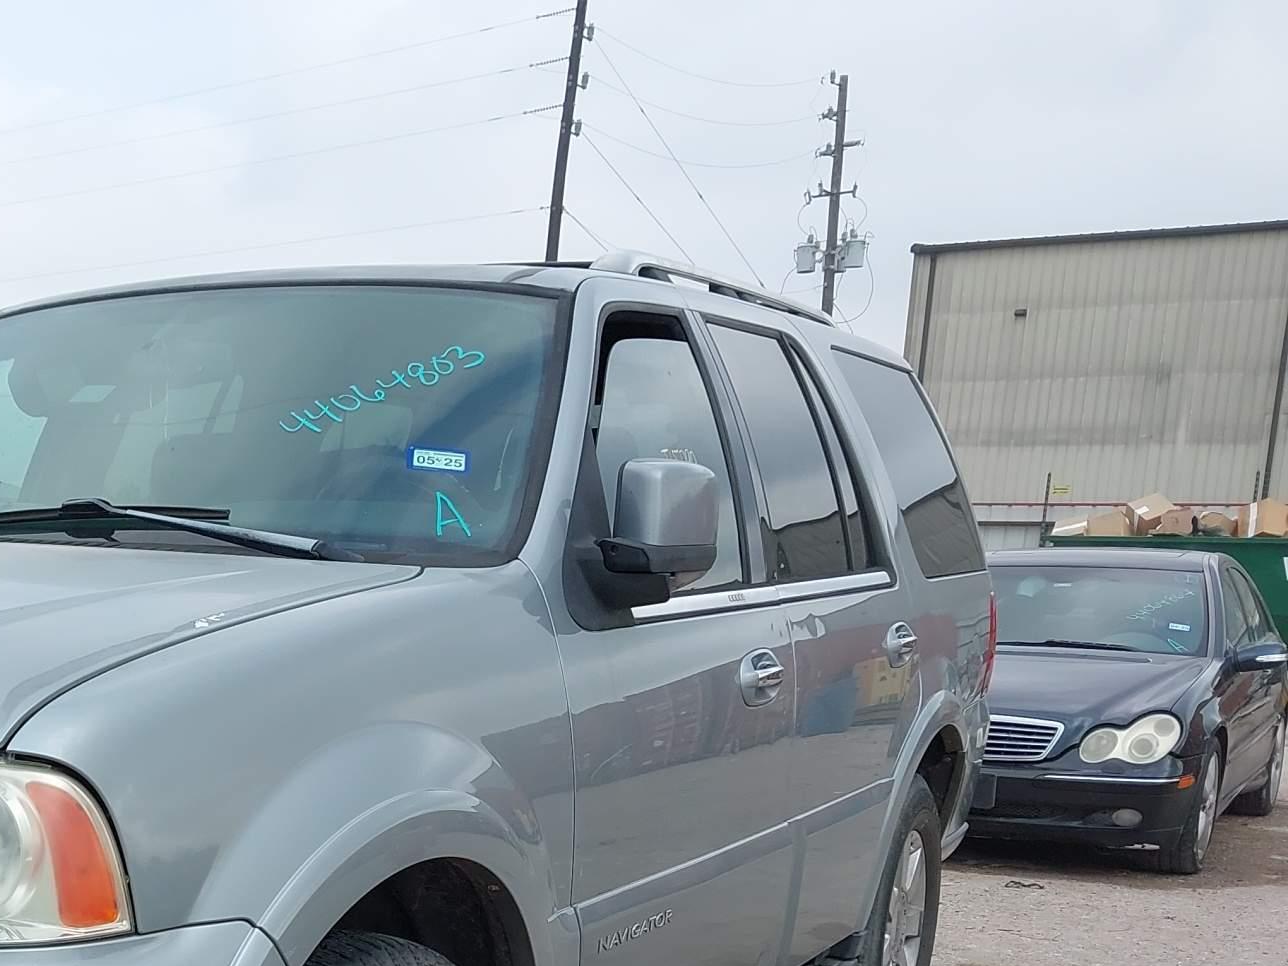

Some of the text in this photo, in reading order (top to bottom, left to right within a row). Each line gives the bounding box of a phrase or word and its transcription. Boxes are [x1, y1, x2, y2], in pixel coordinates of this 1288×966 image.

[279, 345, 486, 433] 44064803
[416, 455, 463, 468] 05 25
[435, 491, 472, 537] A
[1167, 638, 1191, 653] A
[597, 908, 673, 955] NAVIGATOR
